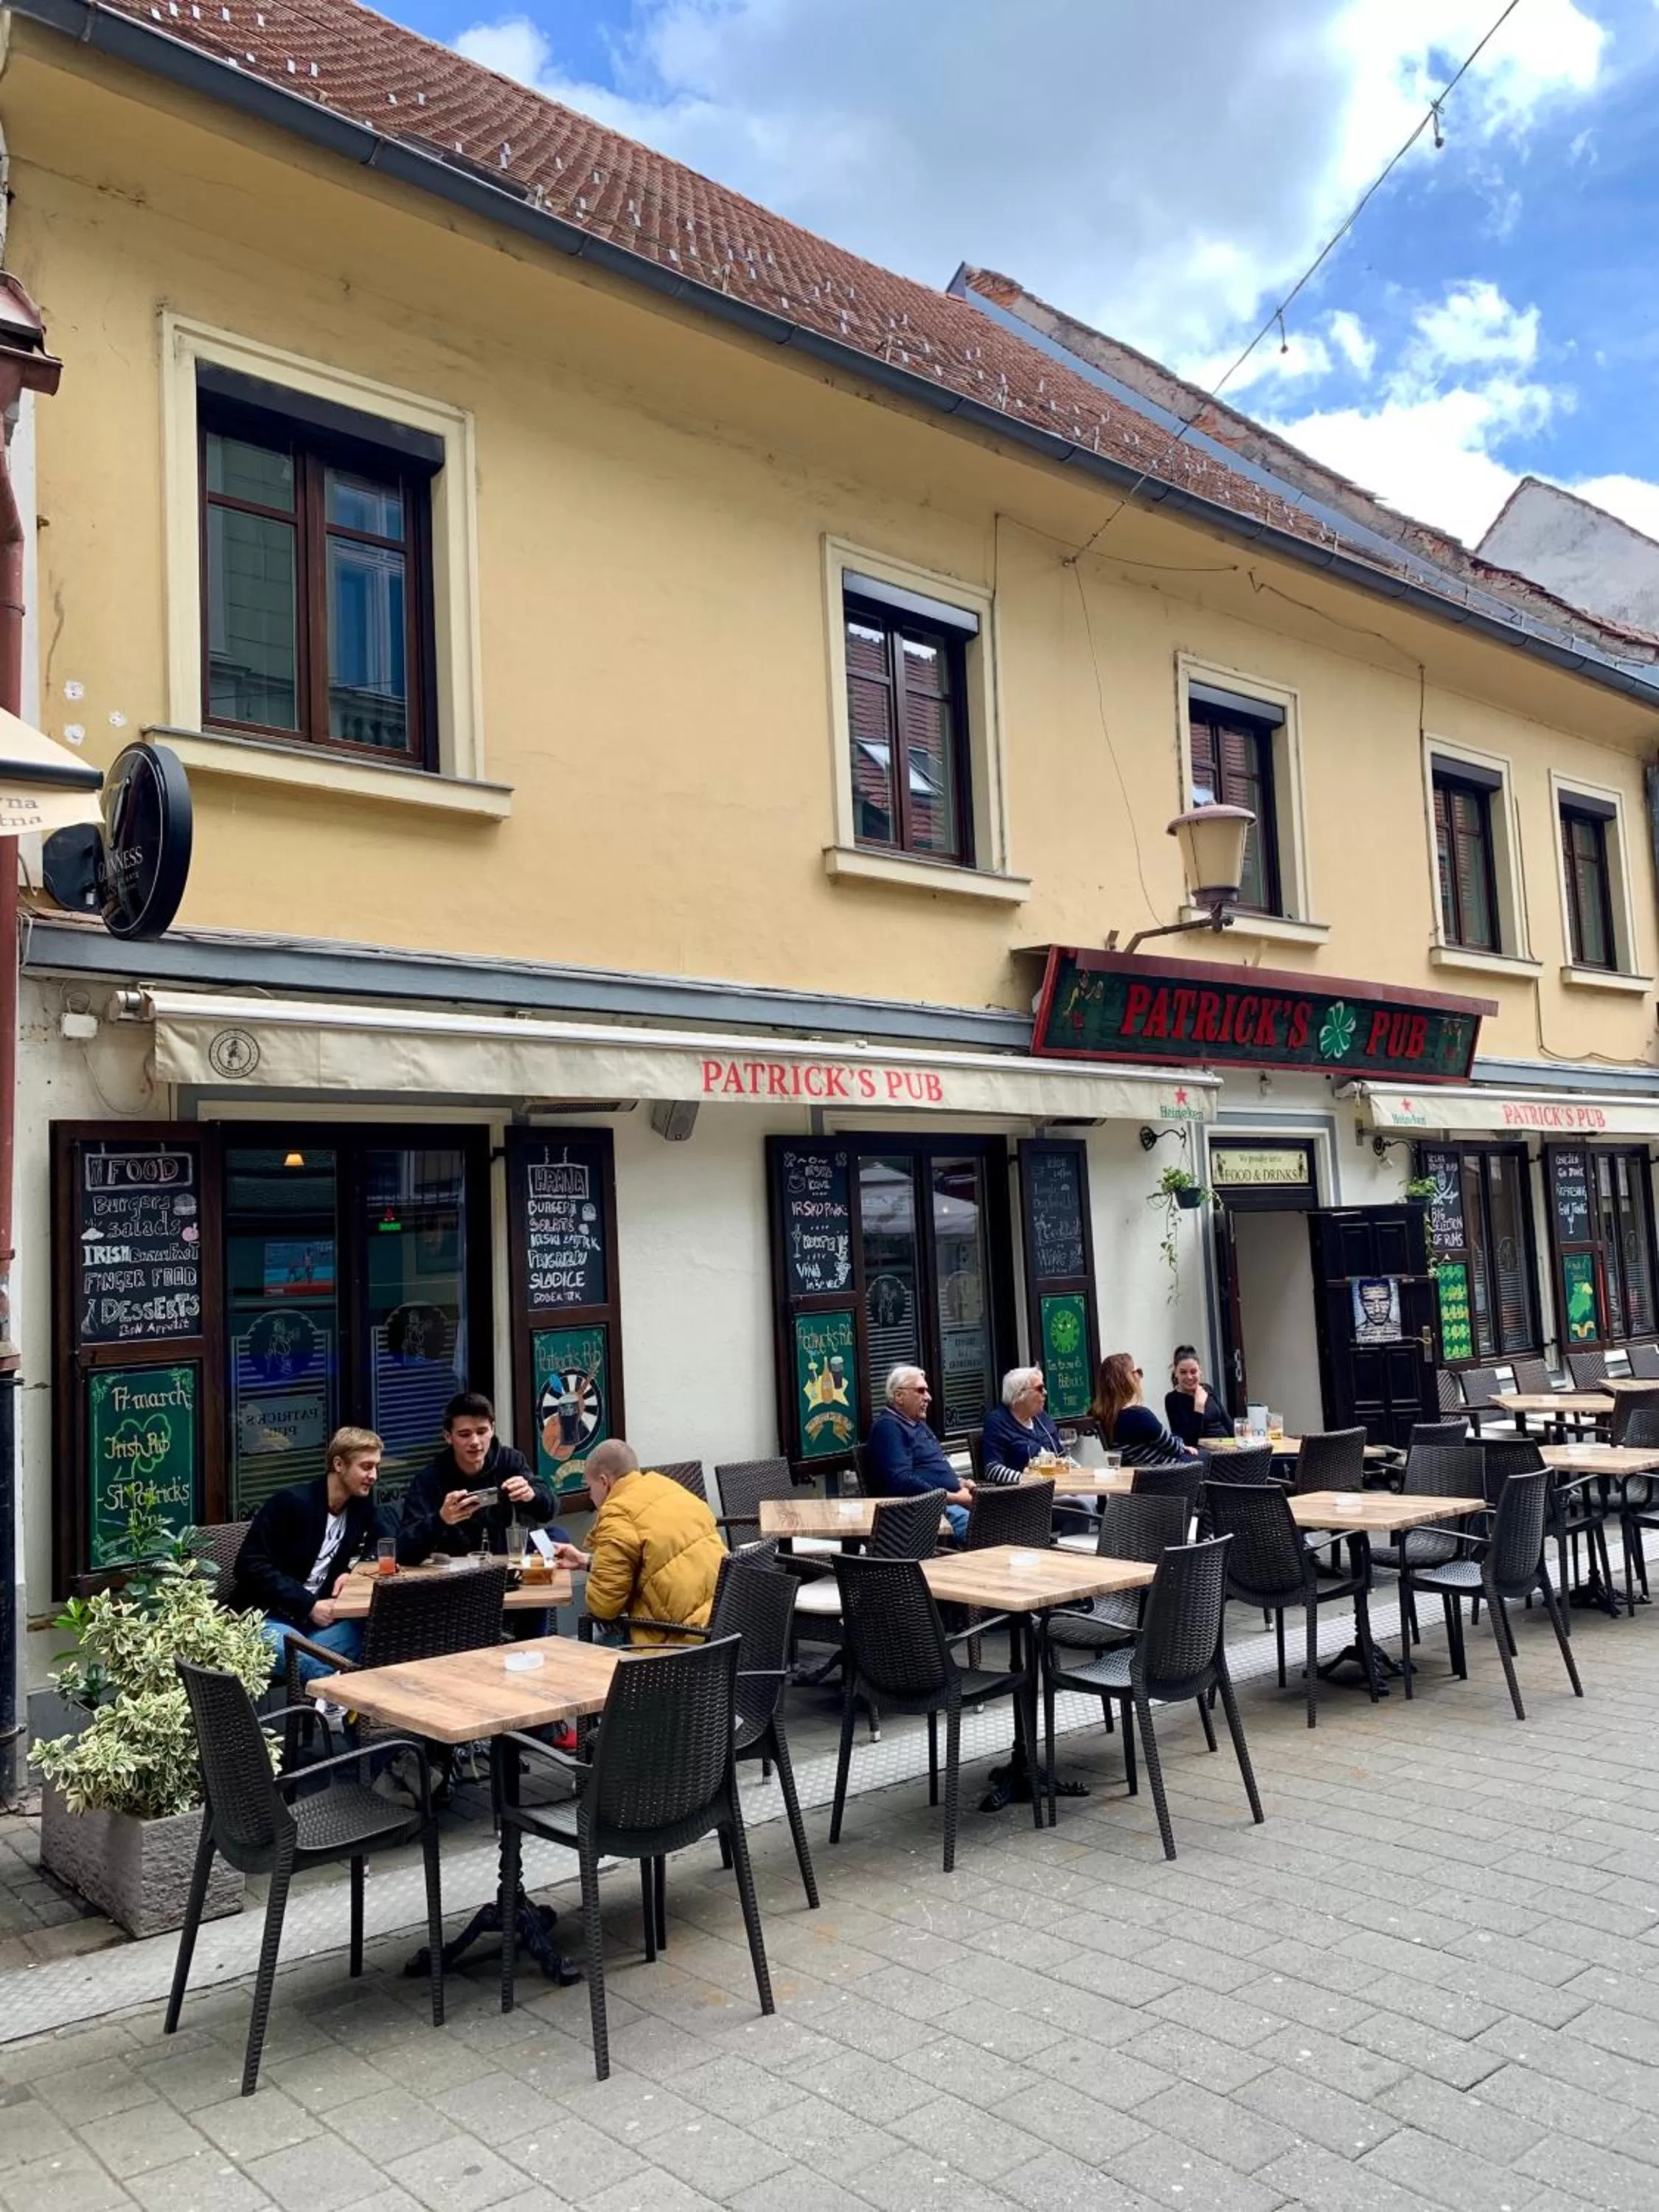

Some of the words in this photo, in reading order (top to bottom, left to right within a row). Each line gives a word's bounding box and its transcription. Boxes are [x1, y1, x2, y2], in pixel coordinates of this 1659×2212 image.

[1121, 984, 1313, 1049] PATRICK'S
[1367, 1010, 1428, 1059] PUB
[702, 1060, 876, 1098] PATRICK'S
[885, 1071, 943, 1102] PUB
[1160, 1105, 1203, 1121] Heineken
[1503, 1105, 1574, 1127] PATRICK'S
[1576, 1108, 1606, 1127] PUB
[107, 1158, 179, 1185] FOOD
[1224, 1169, 1251, 1180] FOOD
[1253, 1169, 1261, 1180] &
[1263, 1169, 1298, 1180] DRINKS
[93, 1195, 170, 1220] Burgers
[1443, 1231, 1464, 1247] RUMS
[83, 1245, 131, 1266] IRISH
[83, 1269, 146, 1293] FINGER
[152, 1267, 197, 1287] FOOD
[528, 1270, 586, 1289] SLADICE
[104, 1434, 142, 1460] Irish
